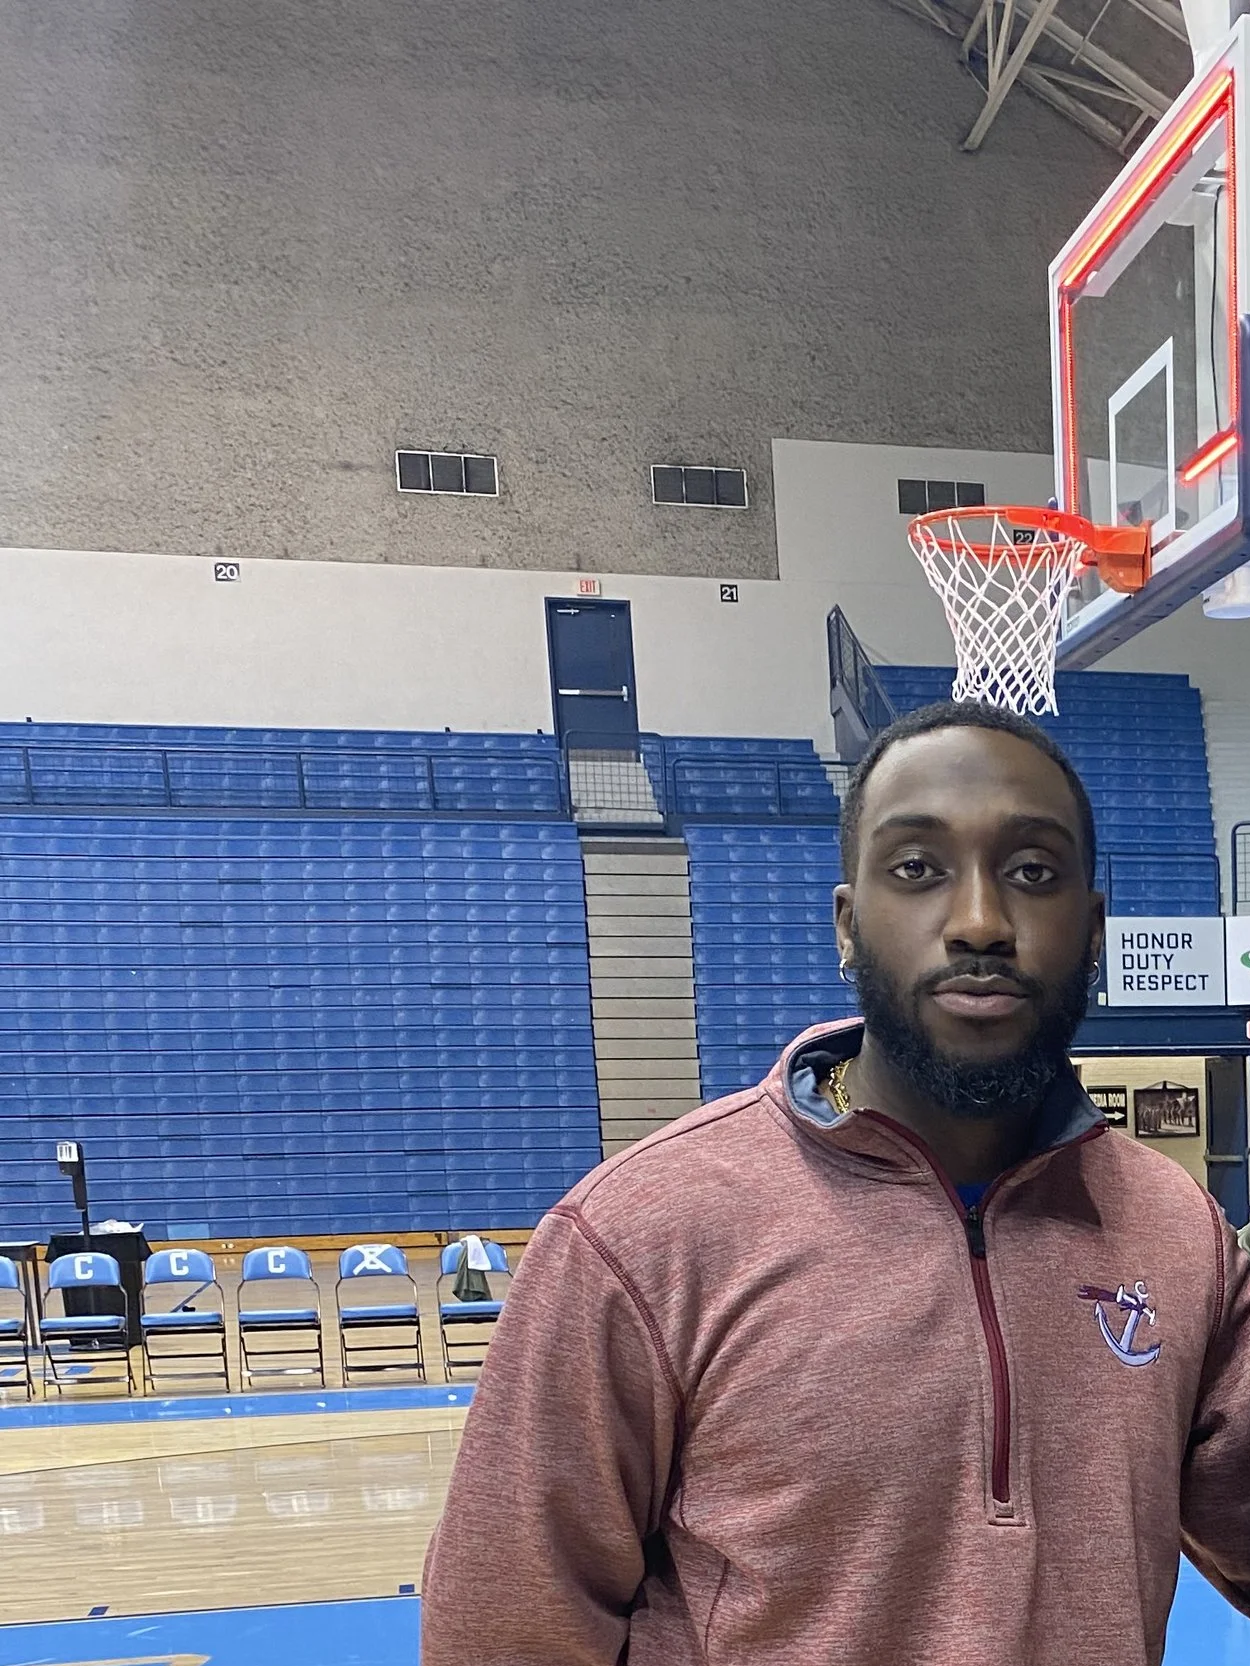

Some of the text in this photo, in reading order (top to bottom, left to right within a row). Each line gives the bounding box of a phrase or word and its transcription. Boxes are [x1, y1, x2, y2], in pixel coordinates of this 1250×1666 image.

[1015, 532, 1033, 544] 22
[216, 565, 238, 579] 20
[722, 587, 736, 600] 21
[1122, 933, 1192, 949] HONOR
[1122, 954, 1174, 970] DUTY
[1122, 974, 1209, 991] RESPECT
[1108, 1093, 1125, 1107] ROOM
[74, 1256, 94, 1280] C
[169, 1251, 189, 1276] C
[267, 1250, 285, 1273] C
